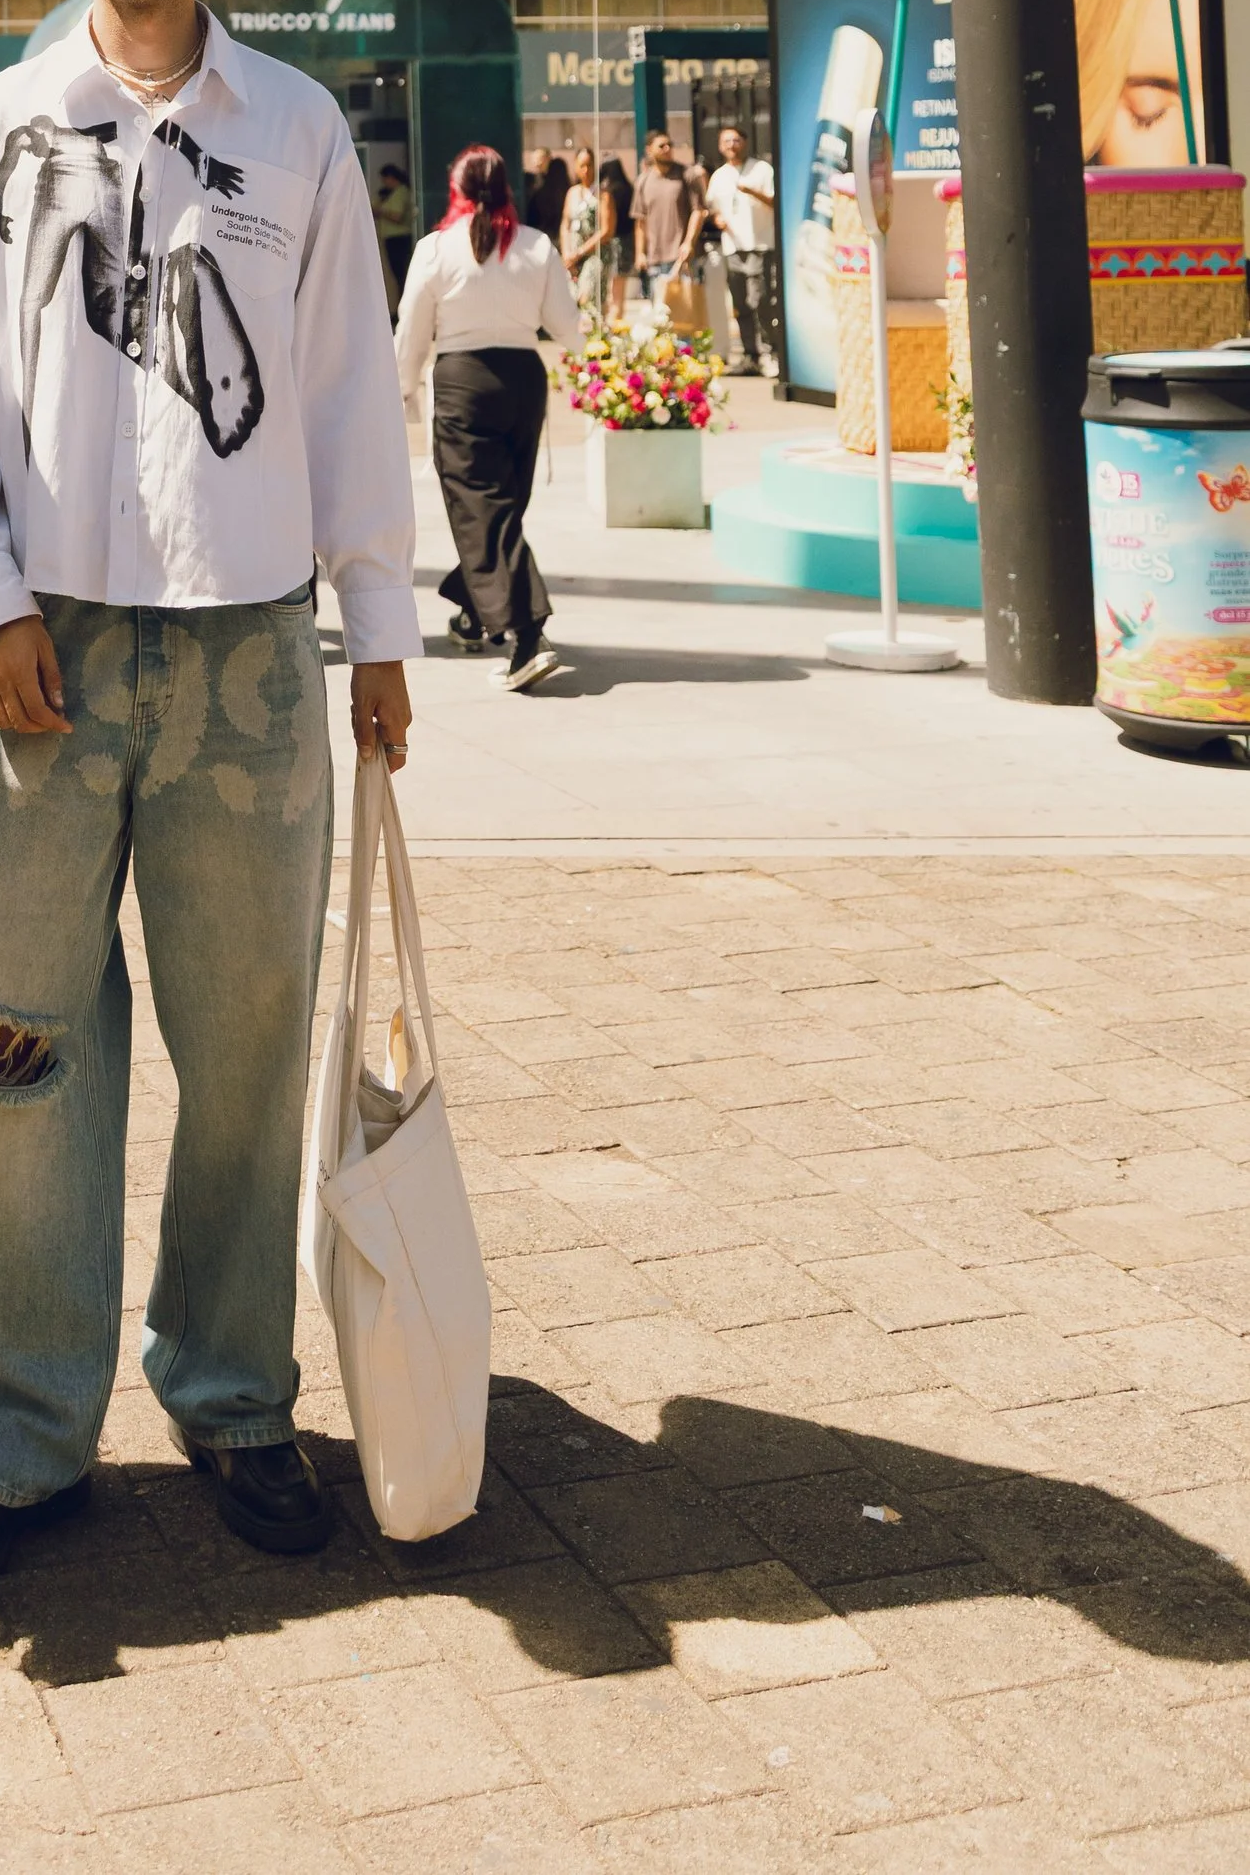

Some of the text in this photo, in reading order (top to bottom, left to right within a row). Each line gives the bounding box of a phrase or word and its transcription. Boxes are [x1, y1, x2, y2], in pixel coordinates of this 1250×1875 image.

[230, 12, 396, 31] TRUCCO'S JEANS
[904, 148, 961, 169] MIENTRA
[211, 205, 258, 223] Undergold
[259, 217, 282, 233] Studio
[216, 229, 253, 245] Capsule
[227, 220, 271, 239] South Side
